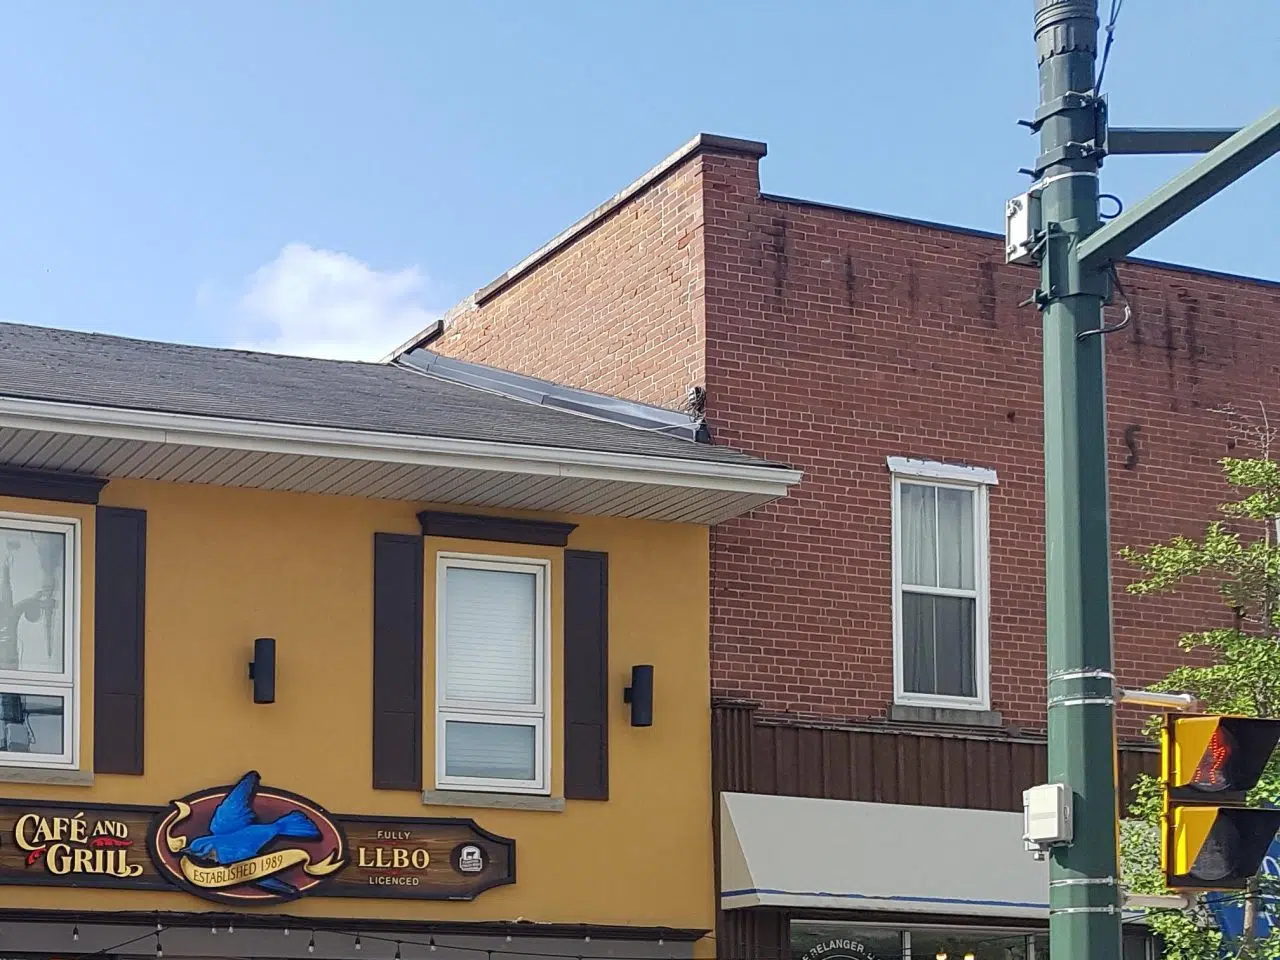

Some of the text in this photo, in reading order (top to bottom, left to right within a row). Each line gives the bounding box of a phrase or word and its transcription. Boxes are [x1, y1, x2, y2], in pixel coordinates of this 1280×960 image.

[15, 811, 128, 851] CAFÉ AND
[377, 830, 411, 840] FULLY
[46, 843, 143, 877] GRILL
[193, 854, 284, 884] ESTABLISHED 1989
[358, 847, 430, 869] LLBO
[369, 876, 419, 887] LICENCED
